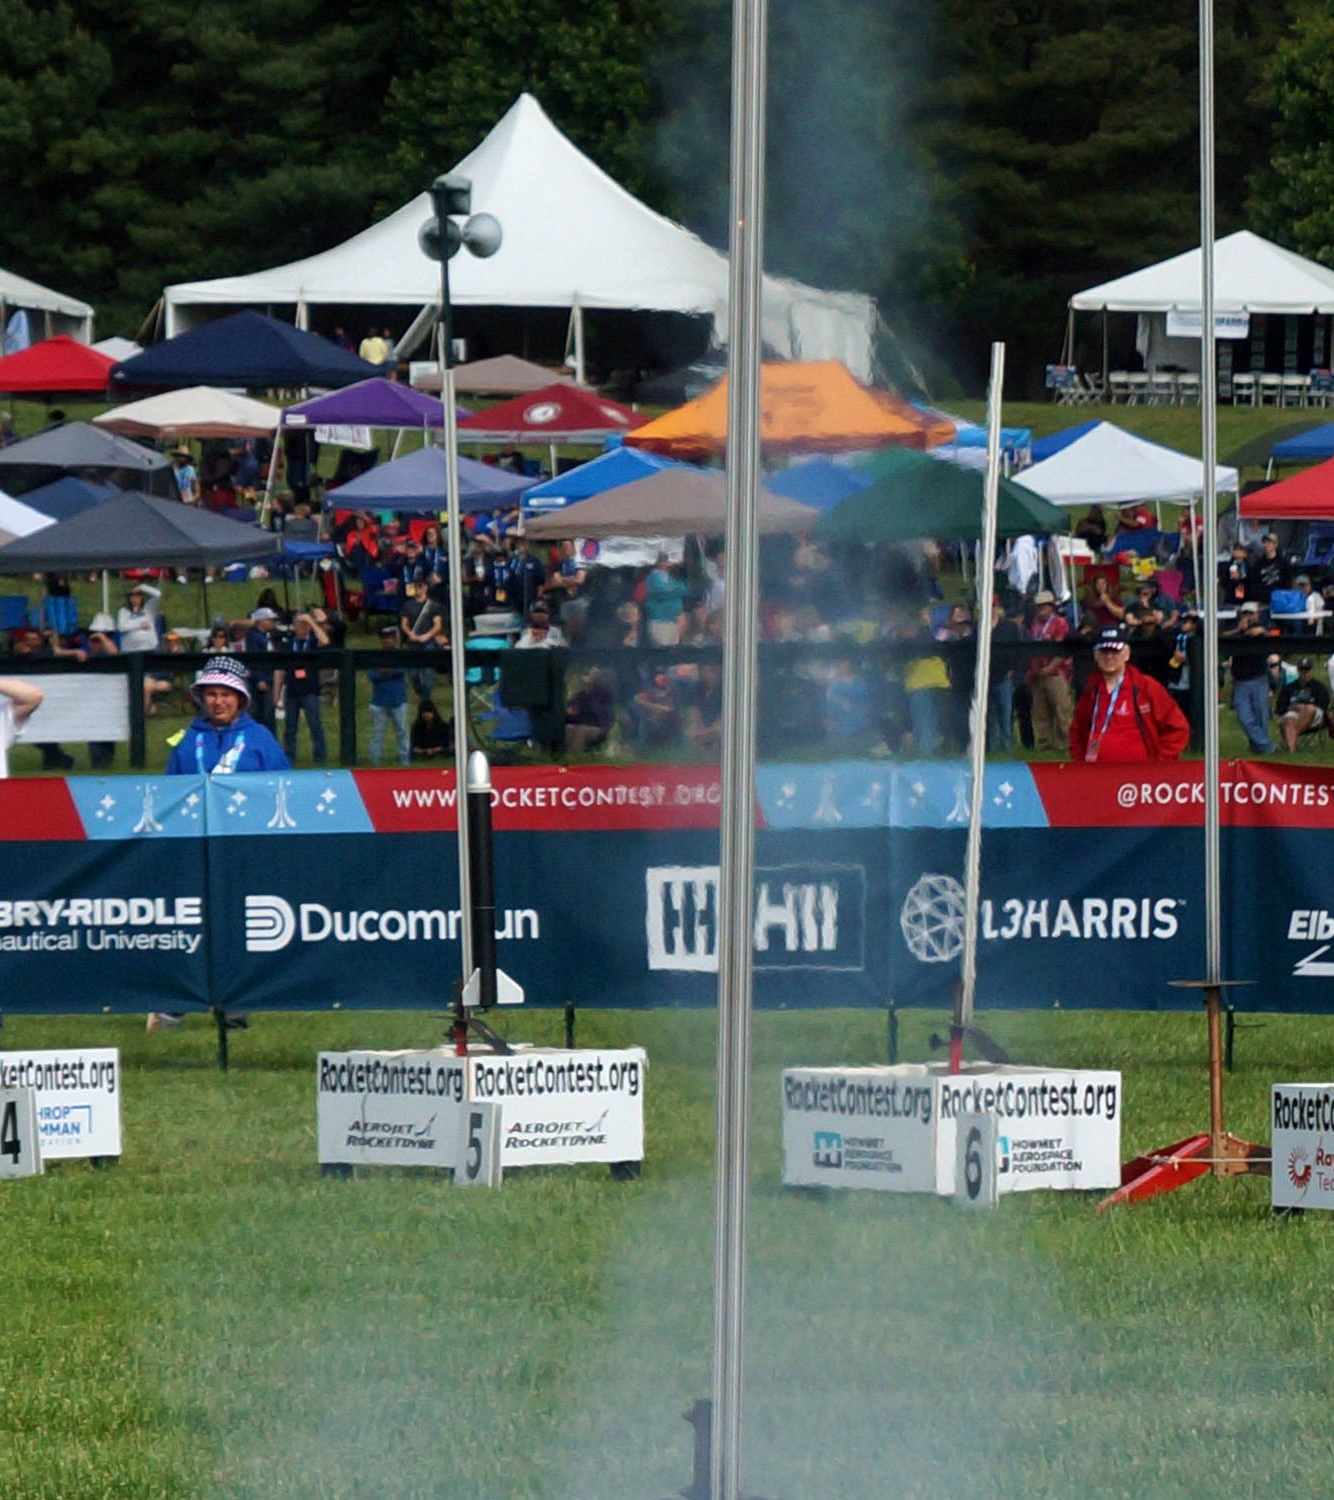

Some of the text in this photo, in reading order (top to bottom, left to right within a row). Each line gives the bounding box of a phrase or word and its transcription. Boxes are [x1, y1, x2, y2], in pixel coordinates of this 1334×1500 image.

[86, 929, 203, 954] University
[320, 1056, 464, 1103] RocketContest.org
[474, 1056, 640, 1097] RocketContest.org
[784, 1075, 933, 1125] RocketContest.org
[940, 1079, 1118, 1121] RocketContest.org
[0, 1100, 22, 1166] 4
[467, 1111, 483, 1182] 5
[505, 1133, 607, 1150] ROCKETDYNE
[965, 1125, 983, 1200] 6
